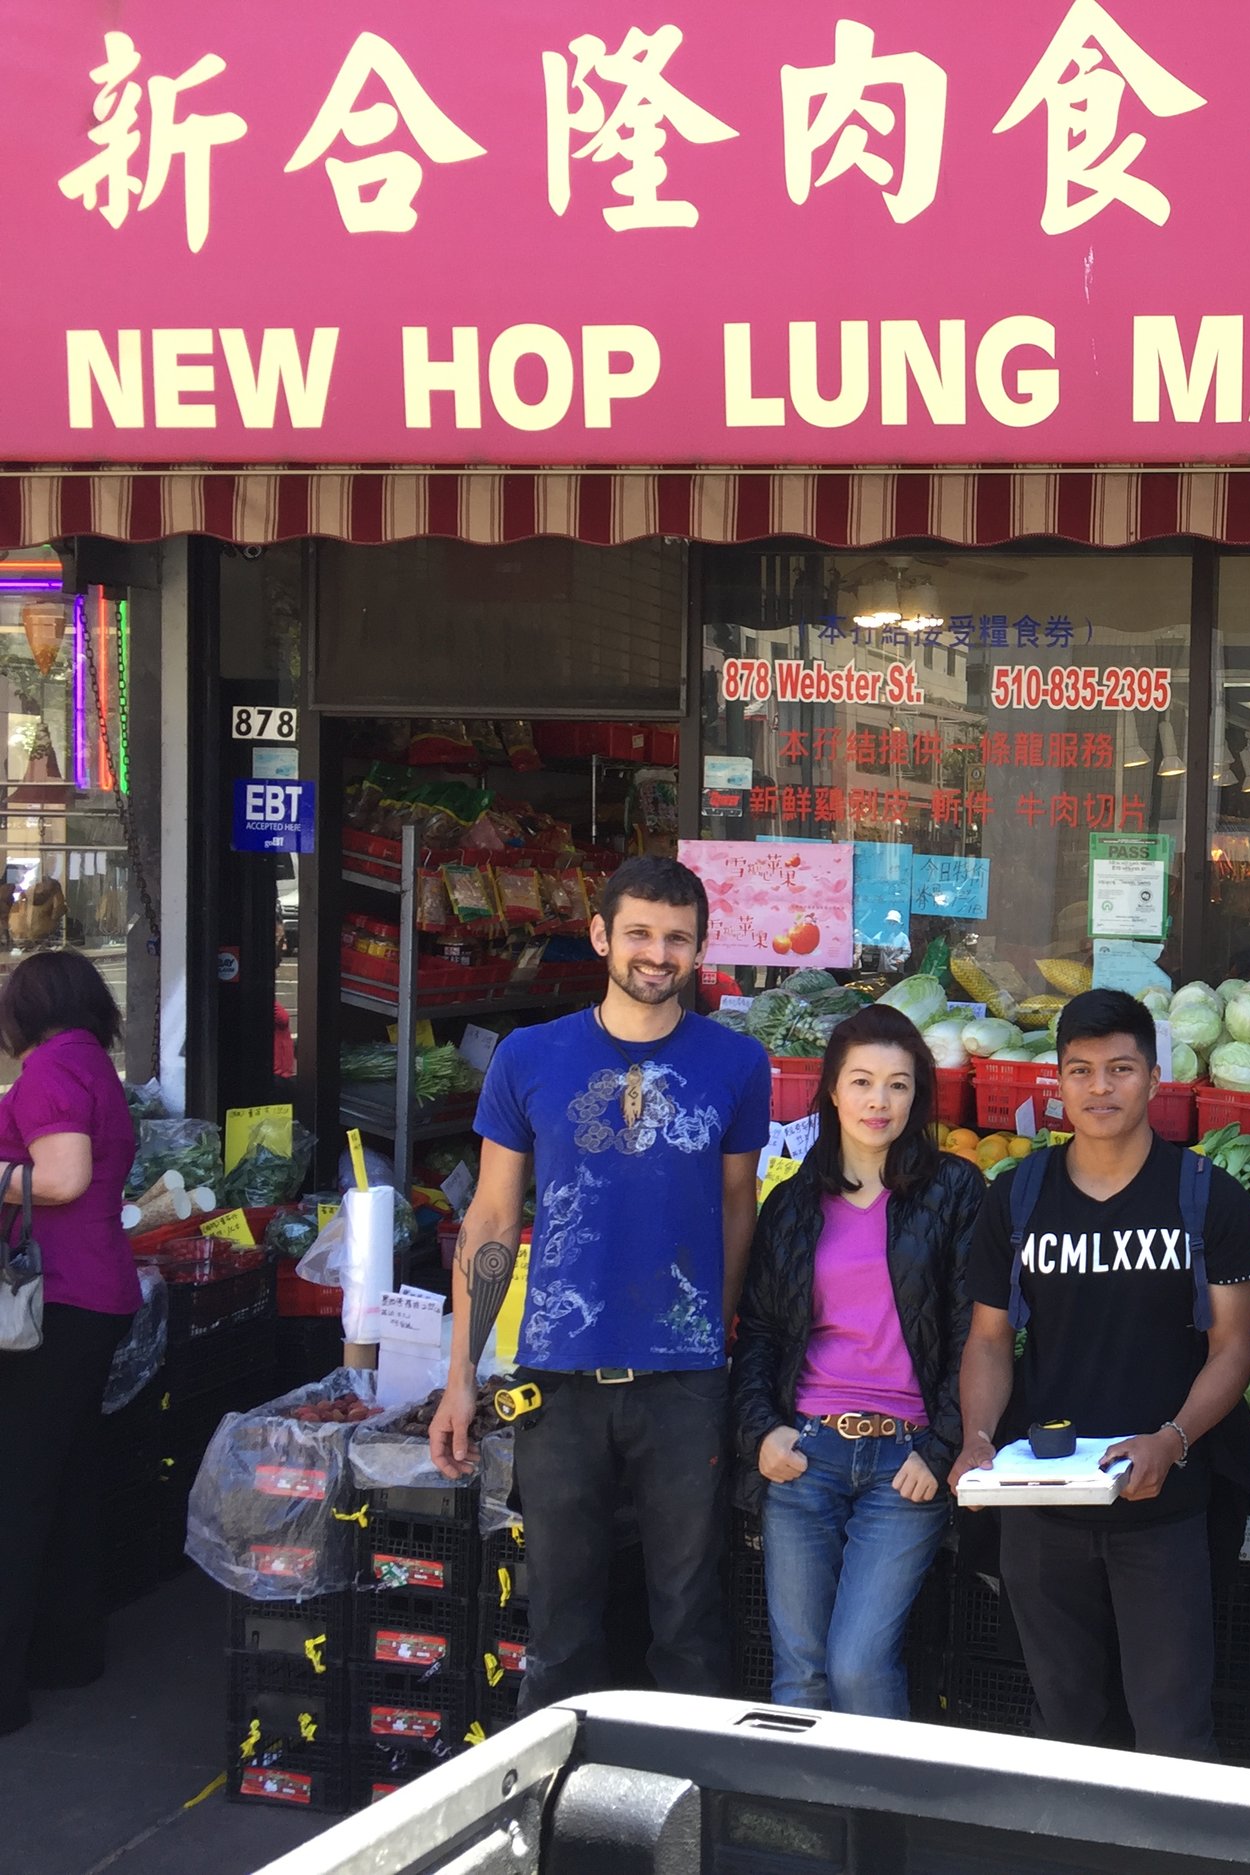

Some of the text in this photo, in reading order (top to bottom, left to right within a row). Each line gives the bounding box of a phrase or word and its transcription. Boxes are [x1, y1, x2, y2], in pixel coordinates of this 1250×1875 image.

[66, 327, 340, 430] NEW
[402, 323, 661, 431] HOP
[723, 314, 1060, 428] LUNG
[722, 658, 925, 706] 878 Webster St.
[992, 664, 1172, 713] 510-835-2395
[235, 708, 294, 739] 878
[245, 785, 303, 822] EBT
[1015, 789, 1145, 829] 牛肉切片
[246, 821, 302, 832] ACCEPTED HERE
[1108, 845, 1150, 859] PASS
